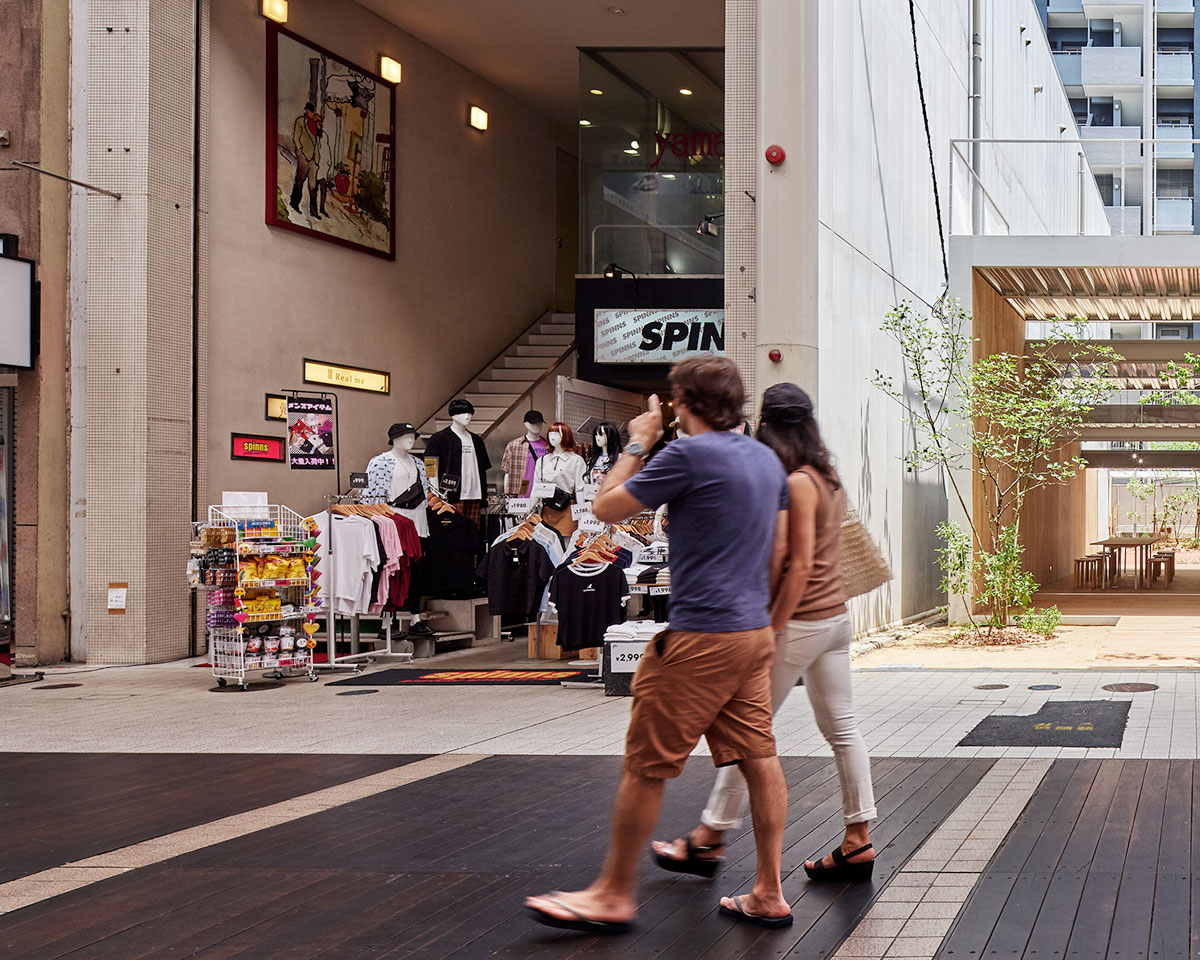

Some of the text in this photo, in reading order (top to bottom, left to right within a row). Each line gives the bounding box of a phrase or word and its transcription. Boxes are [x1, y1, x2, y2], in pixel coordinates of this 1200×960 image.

[638, 321, 725, 351] SPIN
[335, 372, 353, 383] Real
[243, 441, 268, 453] spinns
